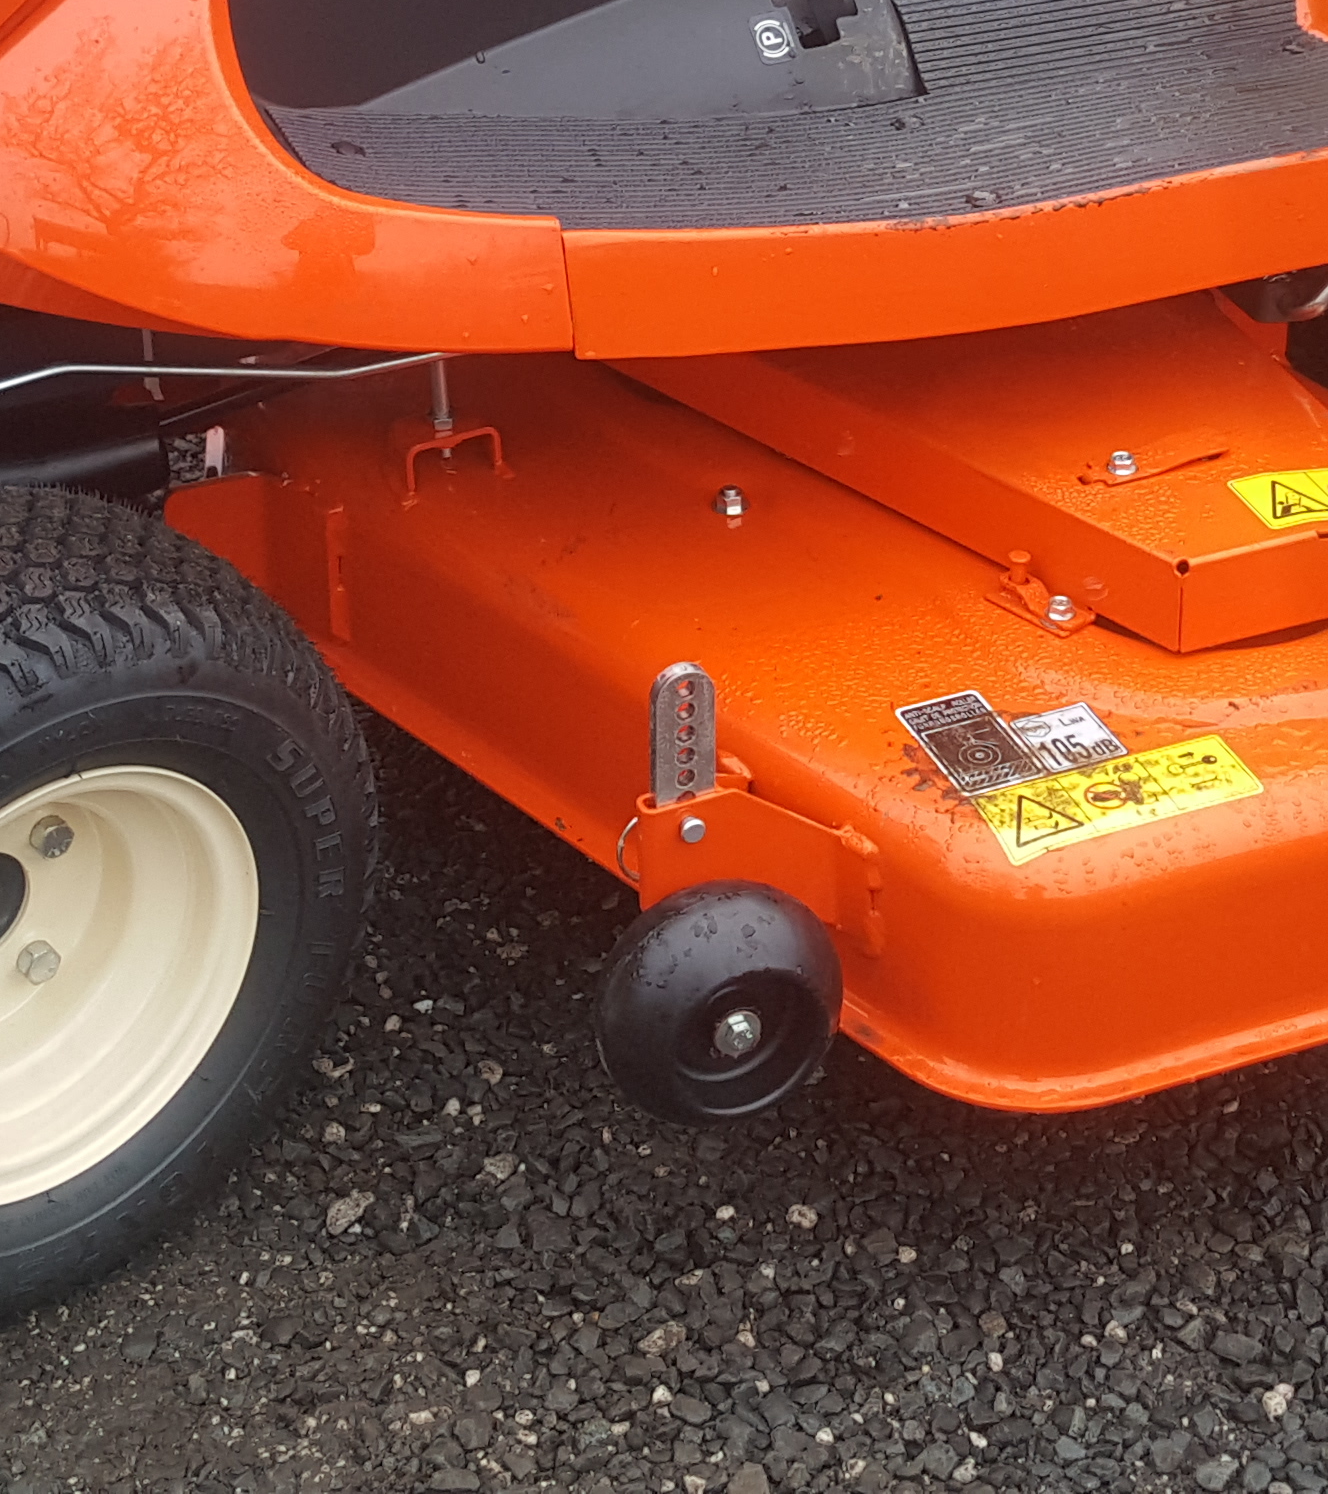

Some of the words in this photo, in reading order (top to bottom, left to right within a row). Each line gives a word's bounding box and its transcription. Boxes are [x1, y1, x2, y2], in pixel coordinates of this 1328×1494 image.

[1037, 733, 1093, 767] 105
[1092, 738, 1121, 757] dB
[266, 737, 345, 899] SUPER
